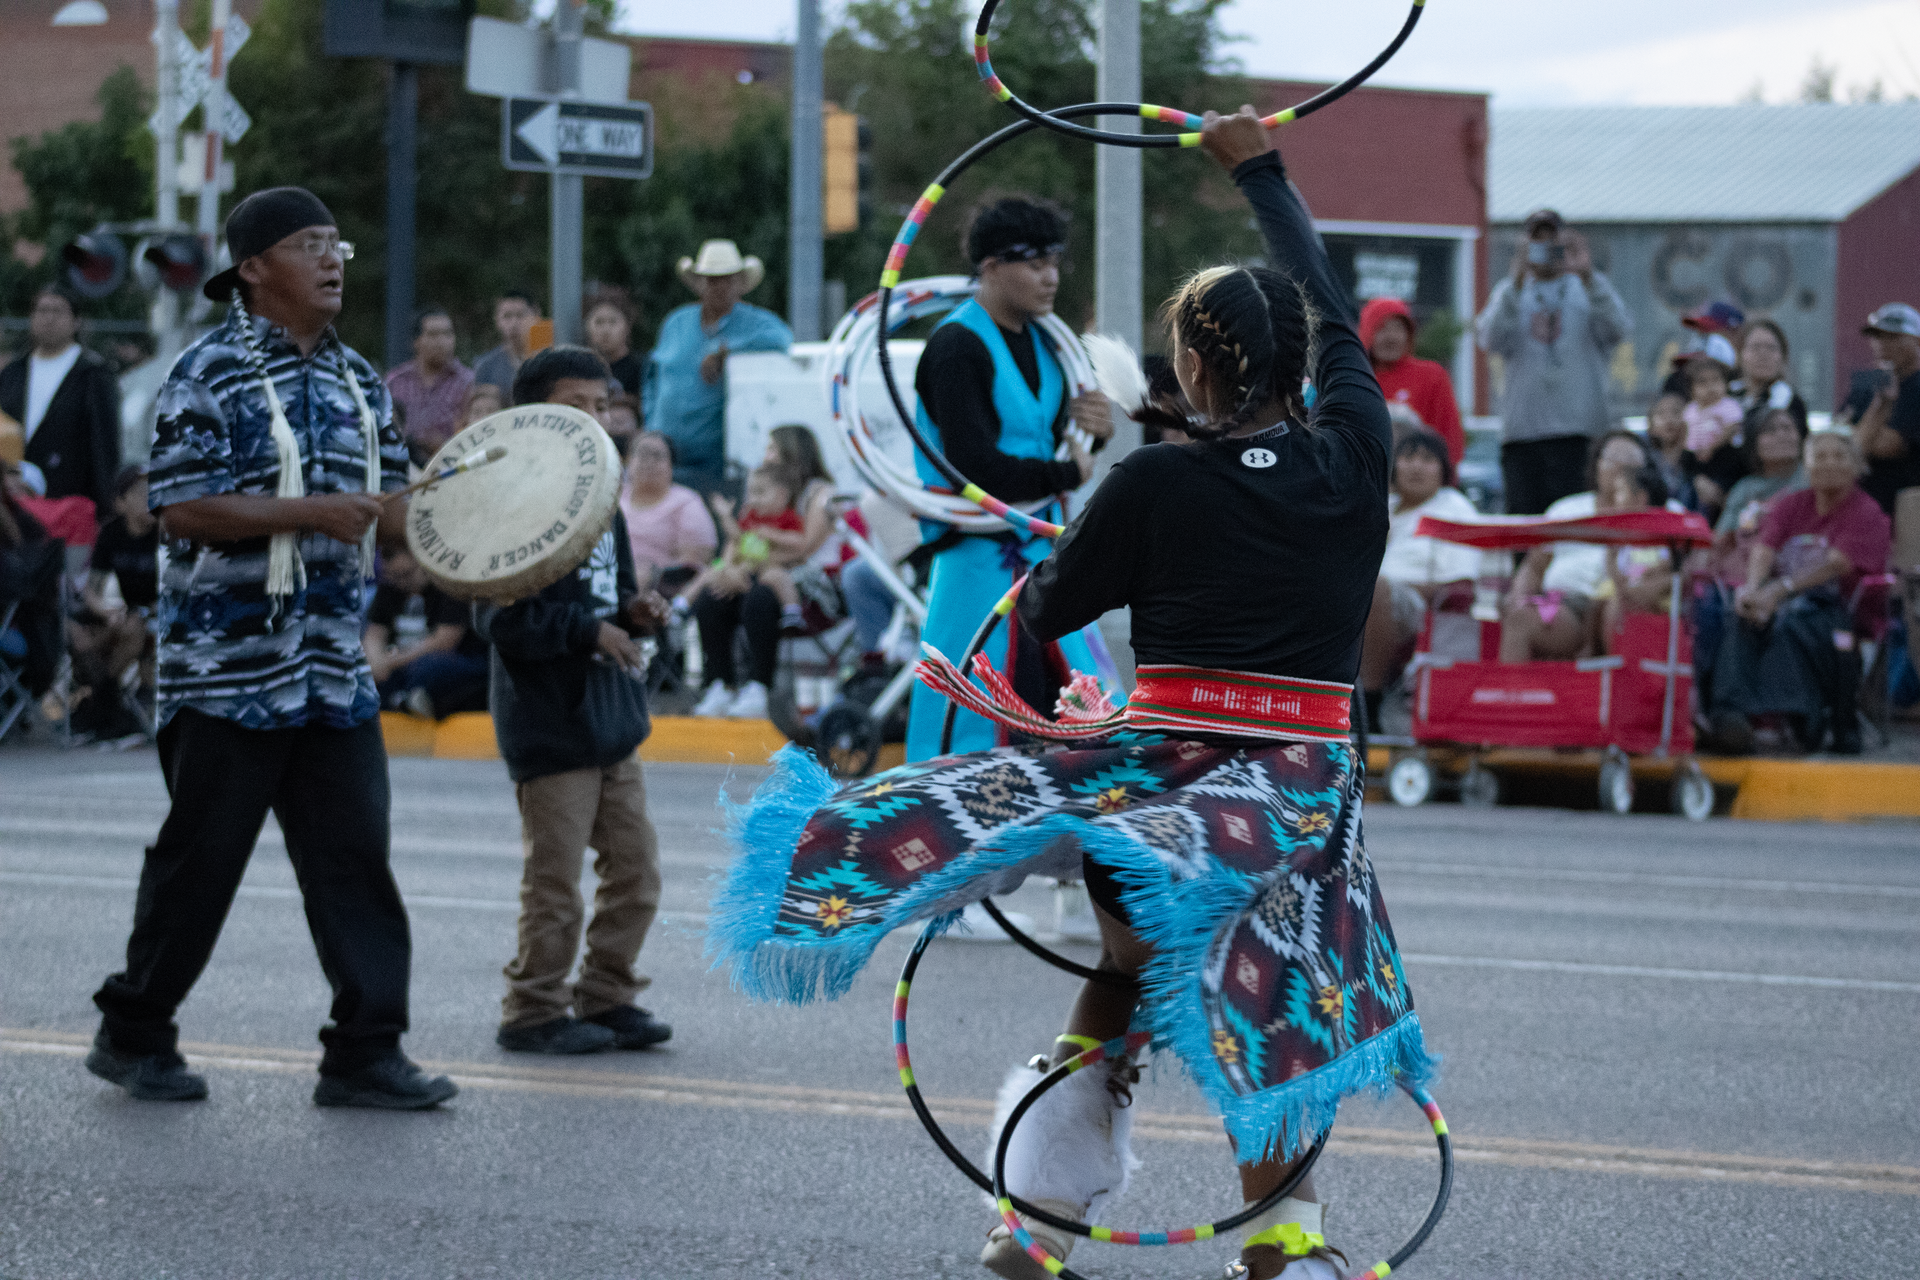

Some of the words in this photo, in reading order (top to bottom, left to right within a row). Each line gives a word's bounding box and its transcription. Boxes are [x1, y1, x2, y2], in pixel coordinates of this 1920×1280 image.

[557, 120, 586, 147] ONE
[602, 125, 639, 149] WAY
[414, 506, 467, 571] RAINBOW
[512, 412, 583, 438] NATIVE
[574, 436, 598, 467] SKY
